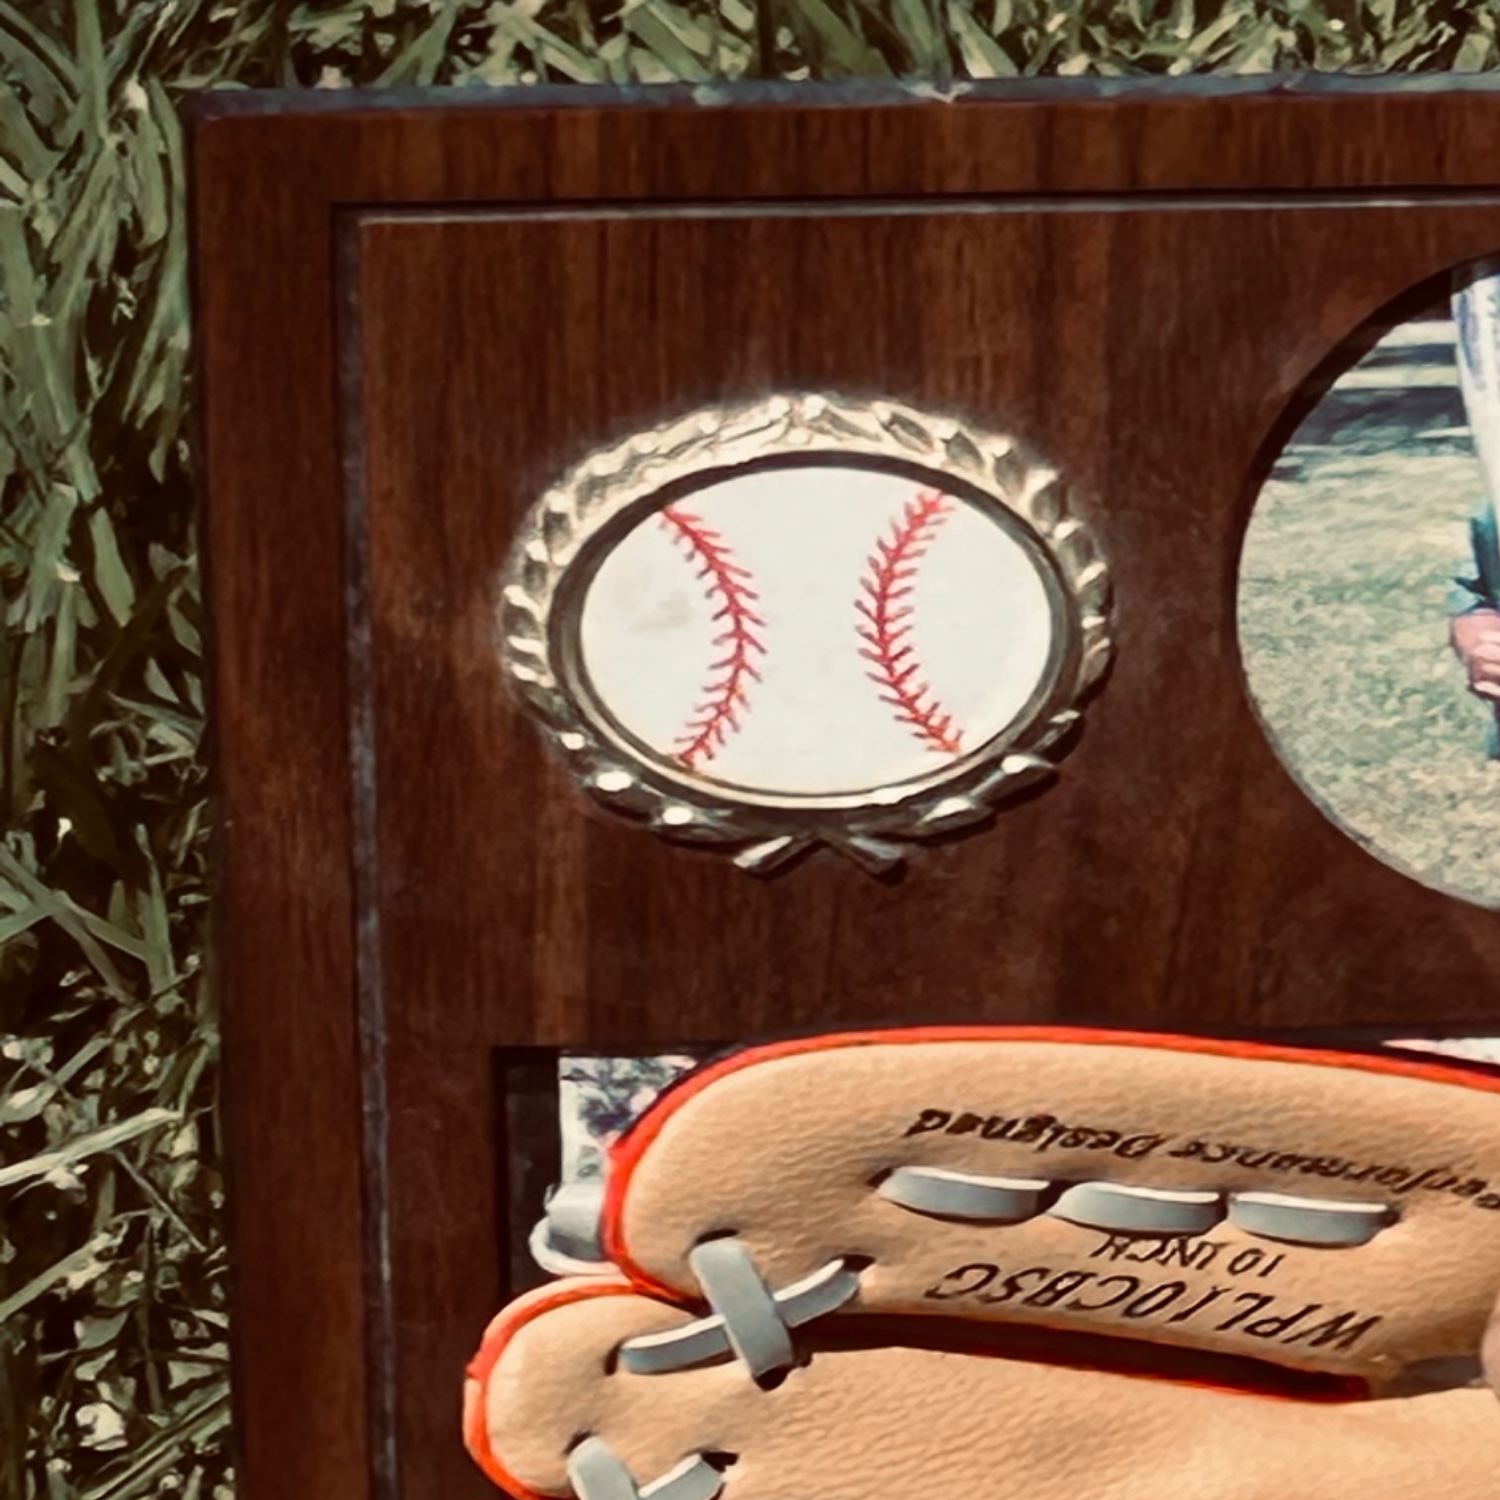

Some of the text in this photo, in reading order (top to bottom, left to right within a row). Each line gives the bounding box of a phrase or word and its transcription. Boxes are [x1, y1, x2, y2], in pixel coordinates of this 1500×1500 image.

[905, 1107, 1165, 1152] Designed
[1091, 1233, 1288, 1278] 10 INCH
